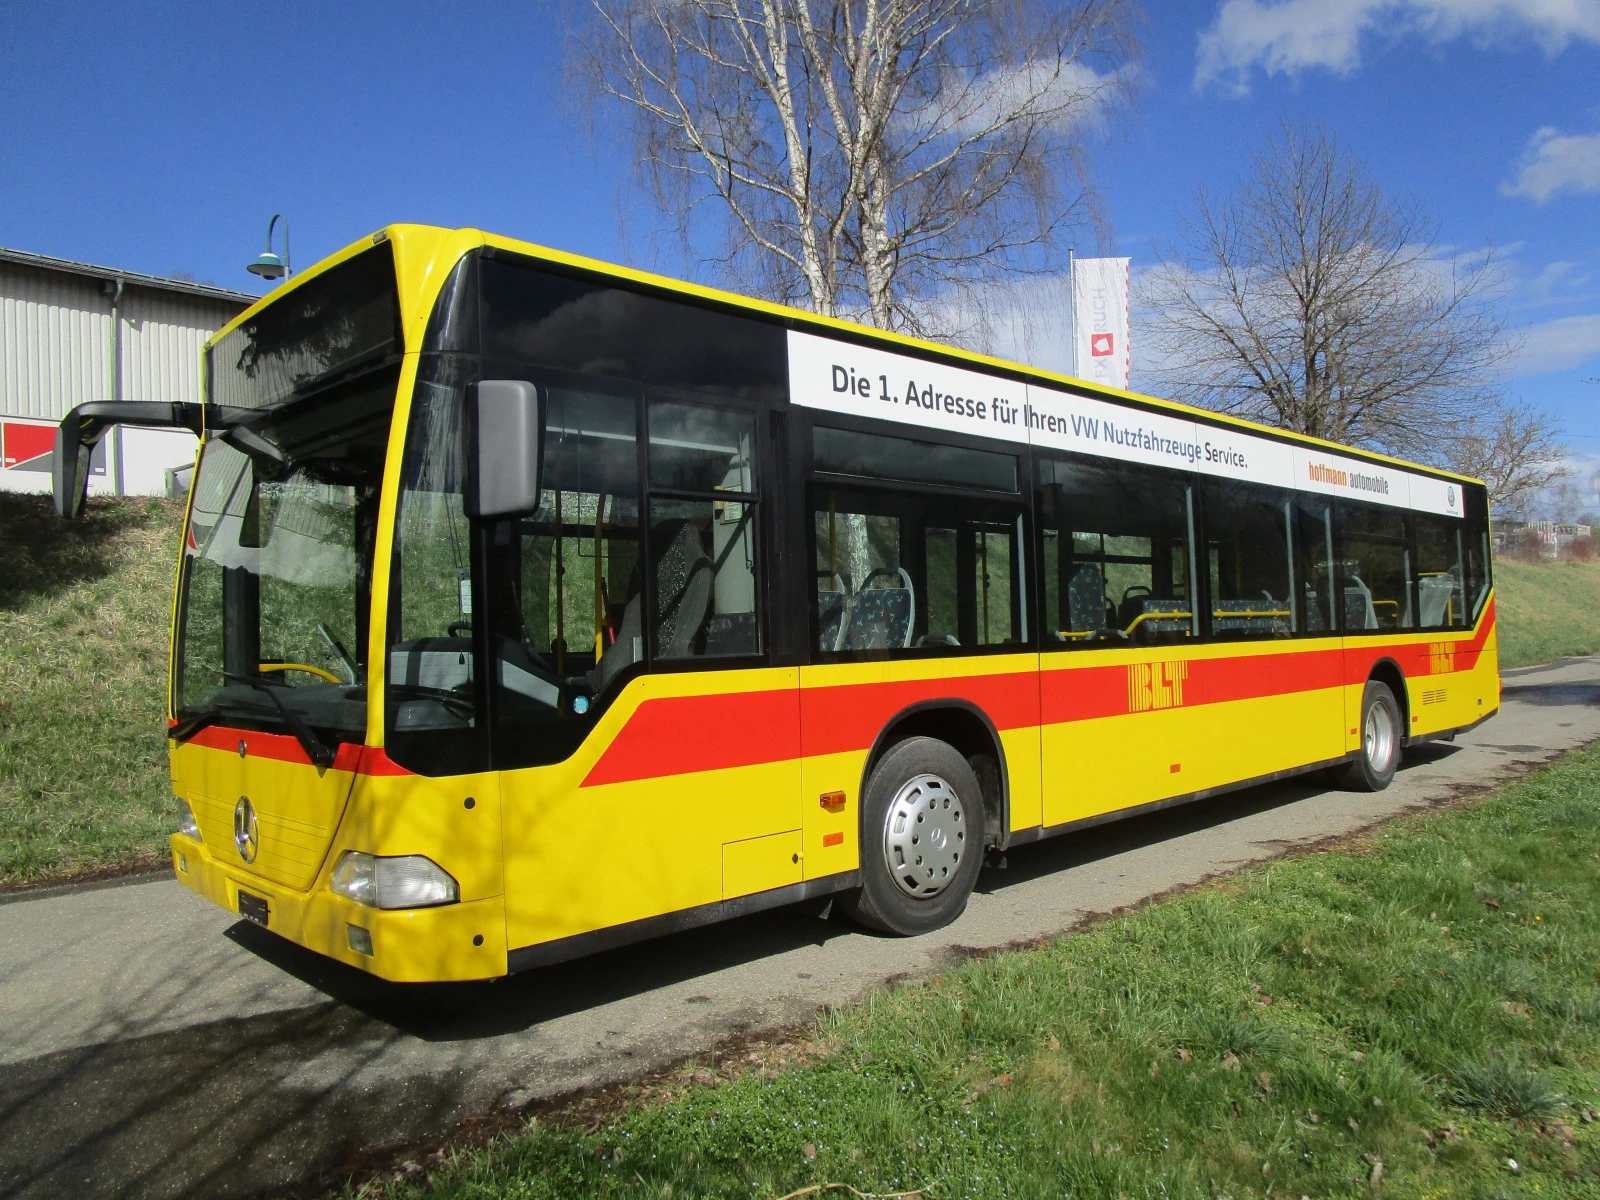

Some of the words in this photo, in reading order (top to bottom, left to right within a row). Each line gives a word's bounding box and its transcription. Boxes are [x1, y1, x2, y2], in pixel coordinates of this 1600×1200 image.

[1093, 287, 1107, 332] RUCH
[831, 364, 870, 398] Die
[879, 374, 899, 404] 1.
[905, 380, 986, 420] Adresse
[992, 397, 1018, 425] für
[1023, 404, 1067, 434] Ihren
[1071, 414, 1099, 440] VW
[1103, 421, 1202, 463] Nutzfahrzeuge
[1205, 442, 1248, 468] Service.
[1309, 461, 1347, 487] hoffmann
[1349, 472, 1389, 495] automobile
[1127, 660, 1188, 713] BLT
